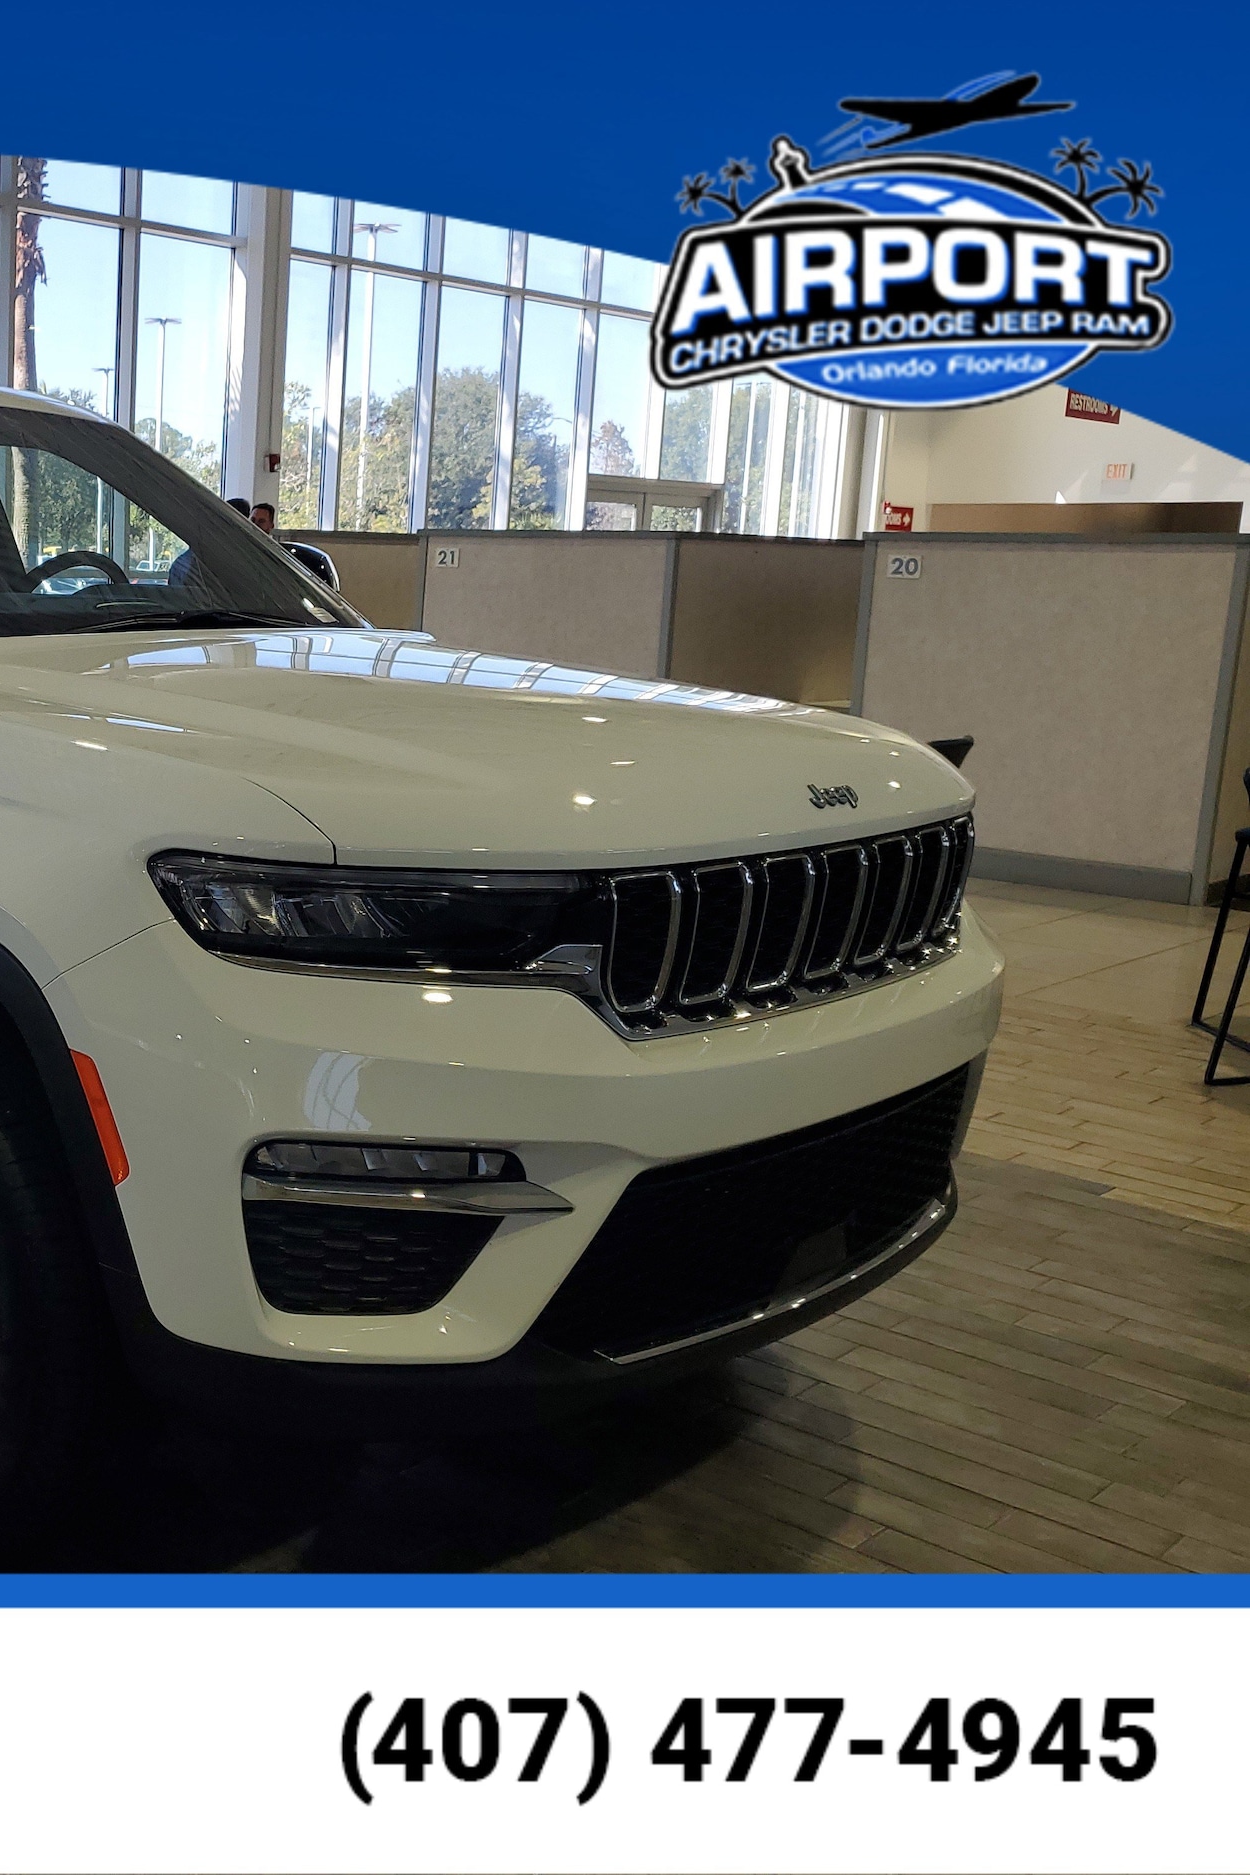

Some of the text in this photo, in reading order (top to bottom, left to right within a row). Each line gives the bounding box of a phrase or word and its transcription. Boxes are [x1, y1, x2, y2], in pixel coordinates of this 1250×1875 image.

[1106, 463, 1128, 479] EXIT
[438, 550, 455, 565] 21
[891, 557, 919, 575] 20
[807, 784, 859, 809] Jeep
